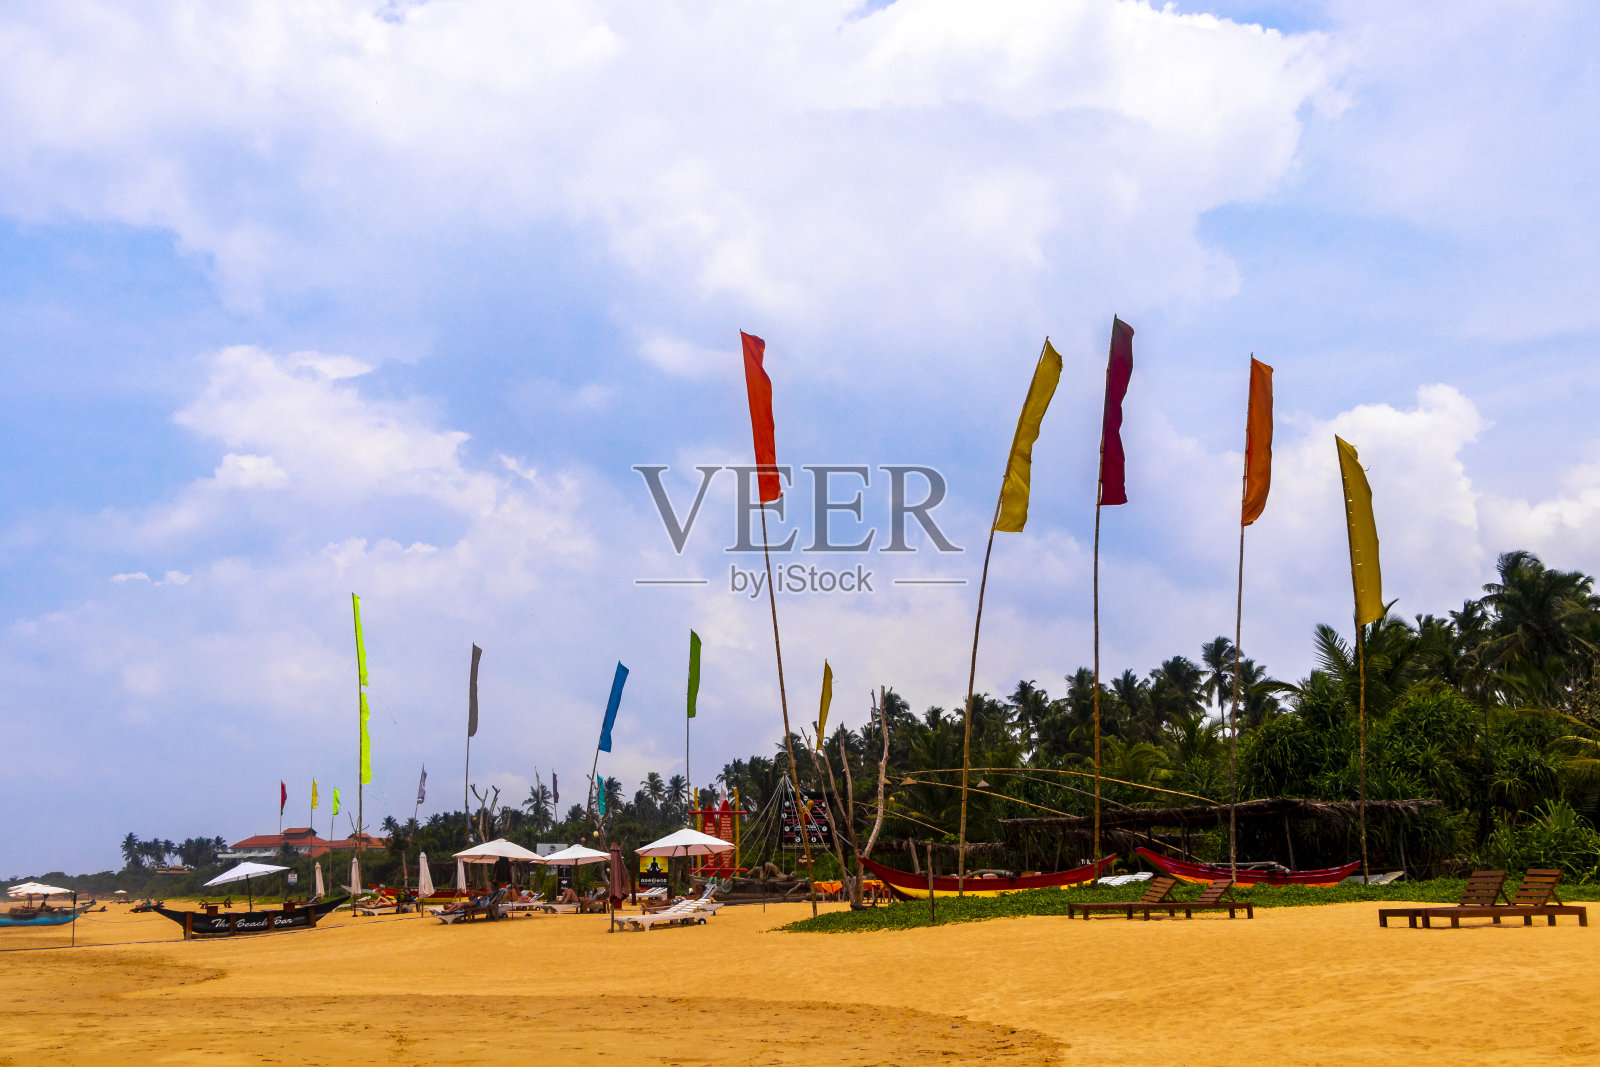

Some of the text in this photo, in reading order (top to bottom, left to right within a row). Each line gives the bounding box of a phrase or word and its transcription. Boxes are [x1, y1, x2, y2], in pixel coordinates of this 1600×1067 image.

[211, 915, 294, 928] The Beach Bar
